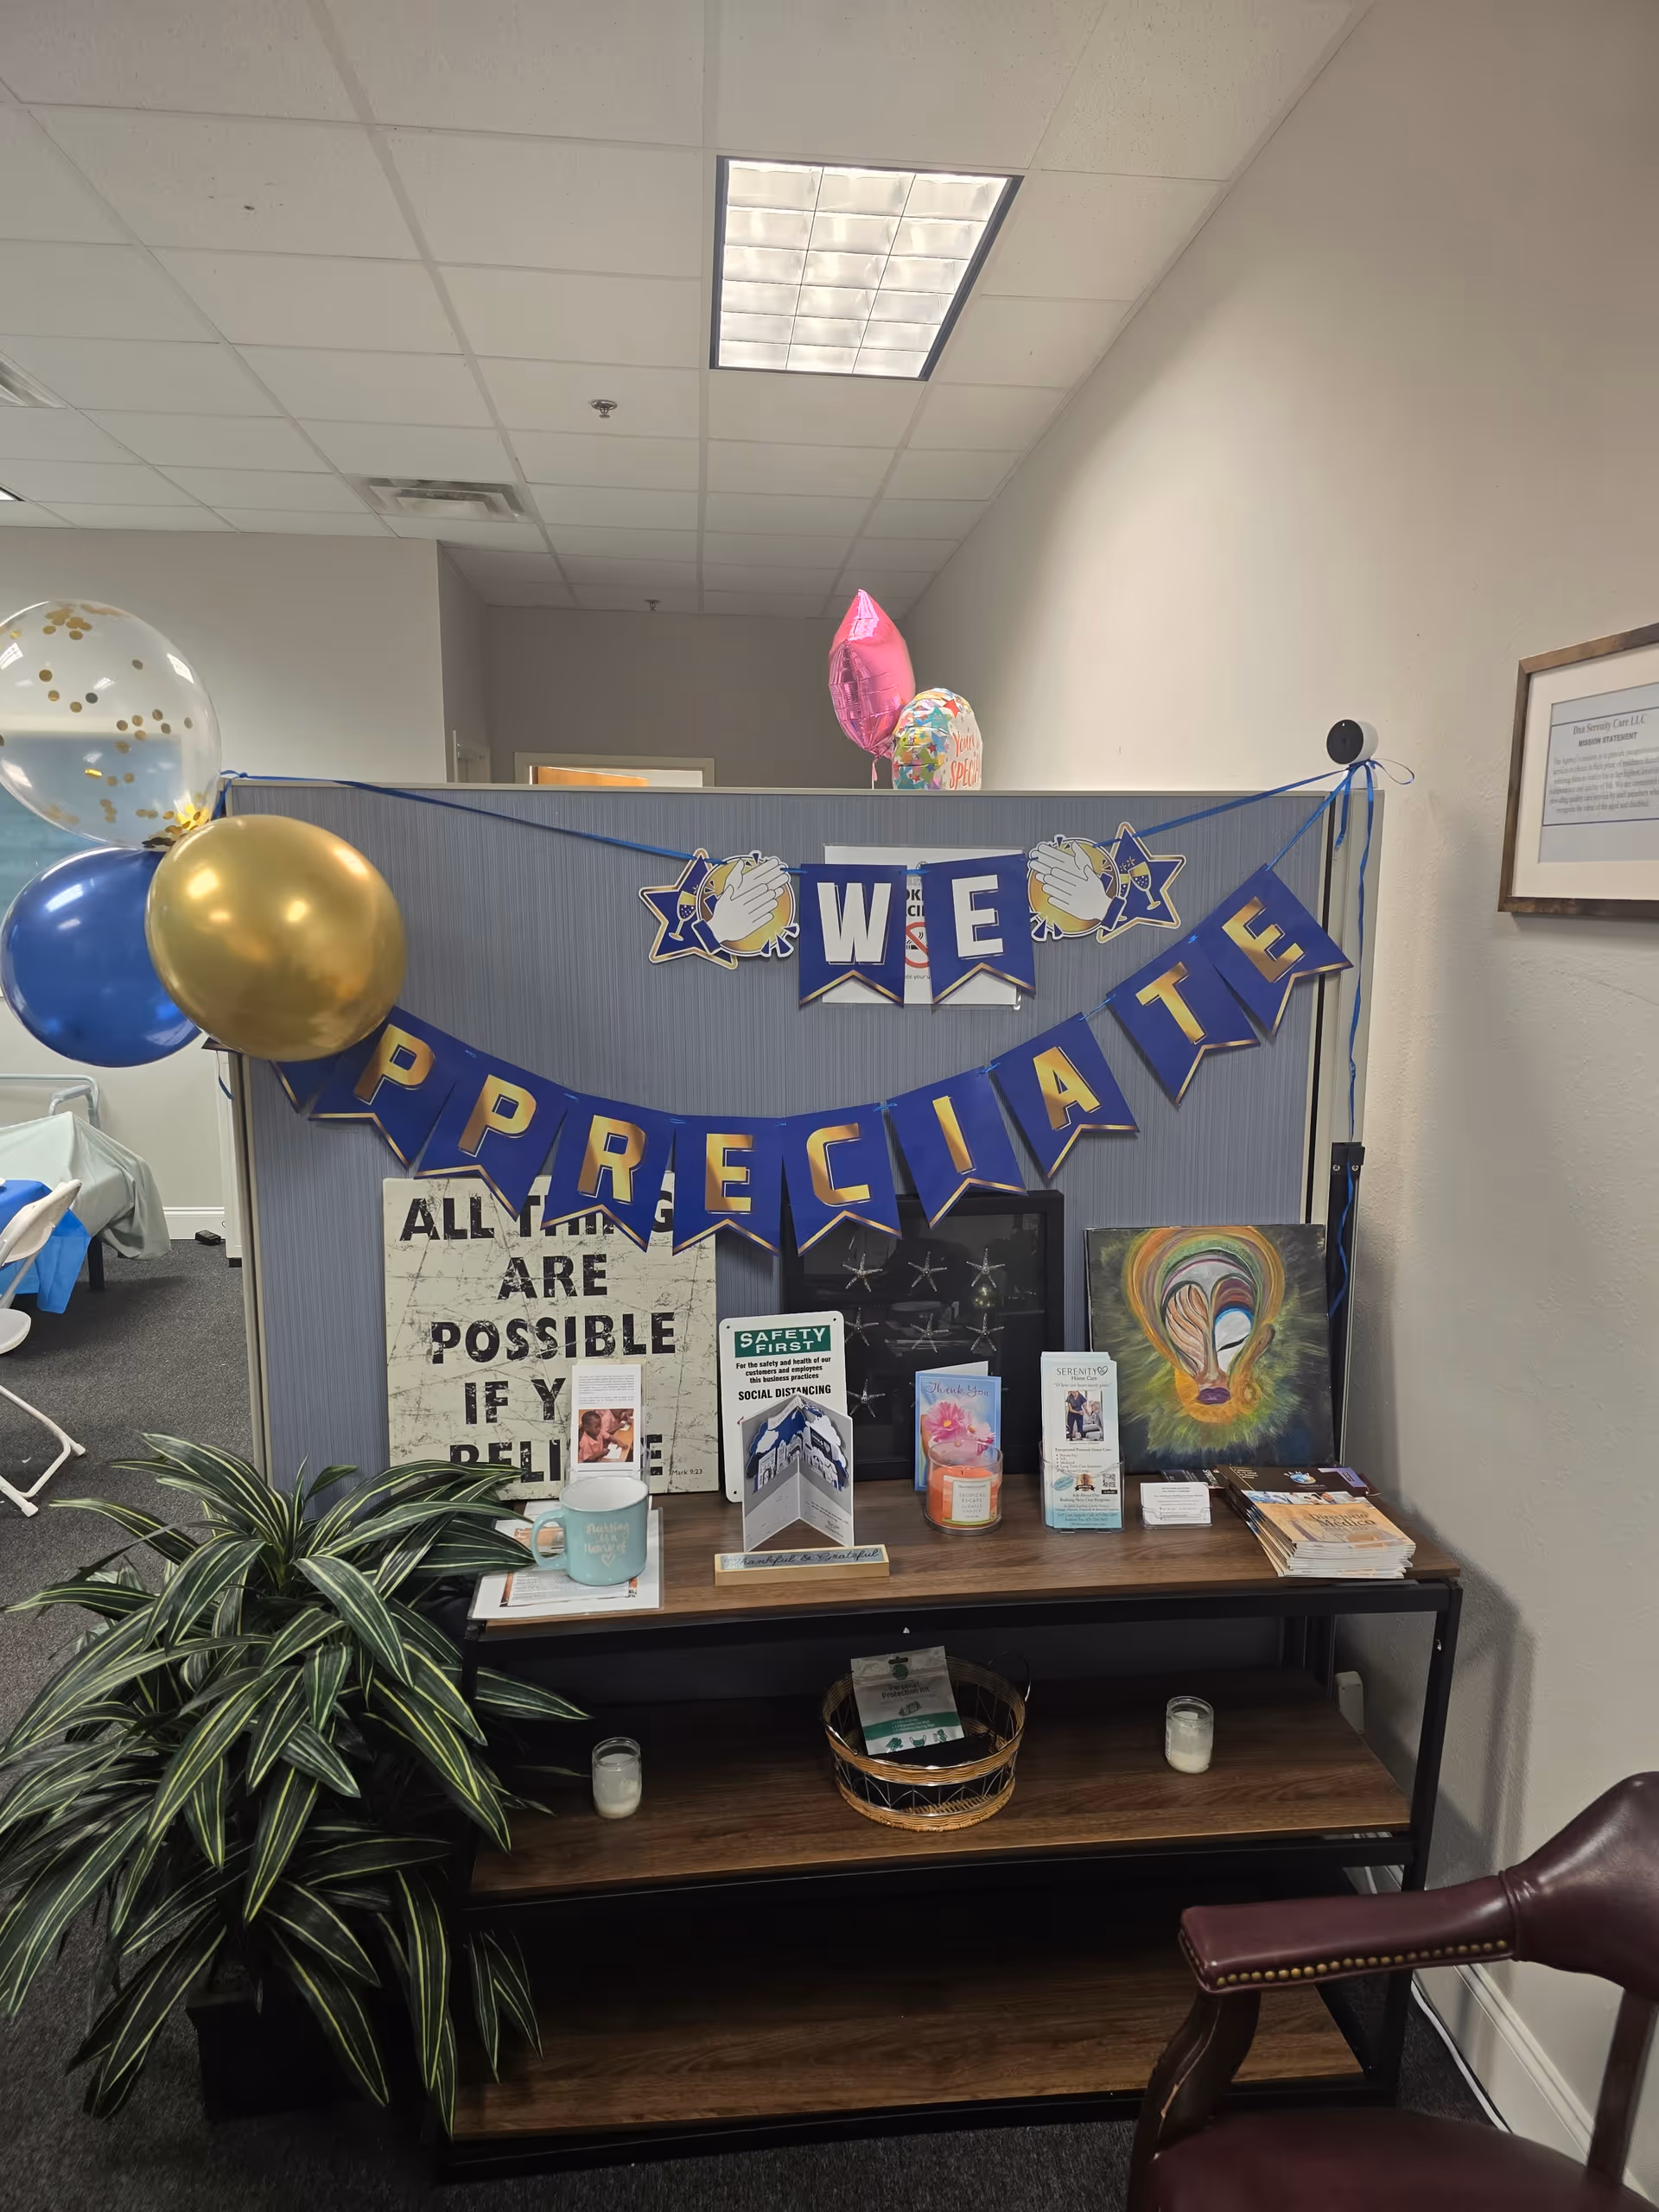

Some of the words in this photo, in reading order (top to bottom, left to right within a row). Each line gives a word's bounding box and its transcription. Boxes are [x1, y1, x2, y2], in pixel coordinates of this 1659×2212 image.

[1586, 720, 1611, 733] Serenity
[1613, 718, 1629, 728] Care
[1630, 715, 1646, 726] LLC
[1578, 736, 1601, 747] MISSION
[1602, 732, 1638, 744] STATEMENT
[399, 1196, 494, 1242] ALL
[497, 1254, 609, 1300] ARE
[430, 1312, 677, 1365] POSSIBLE
[740, 1327, 826, 1349] SAFETY
[755, 1340, 814, 1354] FIRST
[759, 1360, 779, 1369] safety
[1056, 1367, 1097, 1376] SERENITY
[791, 1373, 819, 1382] practices
[738, 1389, 773, 1401] SOCIAL
[775, 1384, 831, 1398] DISTANCING
[926, 1382, 963, 1395] Thank
[966, 1384, 989, 1398] You
[463, 1380, 510, 1426] IF
[799, 1554, 812, 1562] &
[817, 1548, 879, 1562] Grateful
[888, 1681, 919, 1691] Personal
[881, 1688, 918, 1700] Protection
